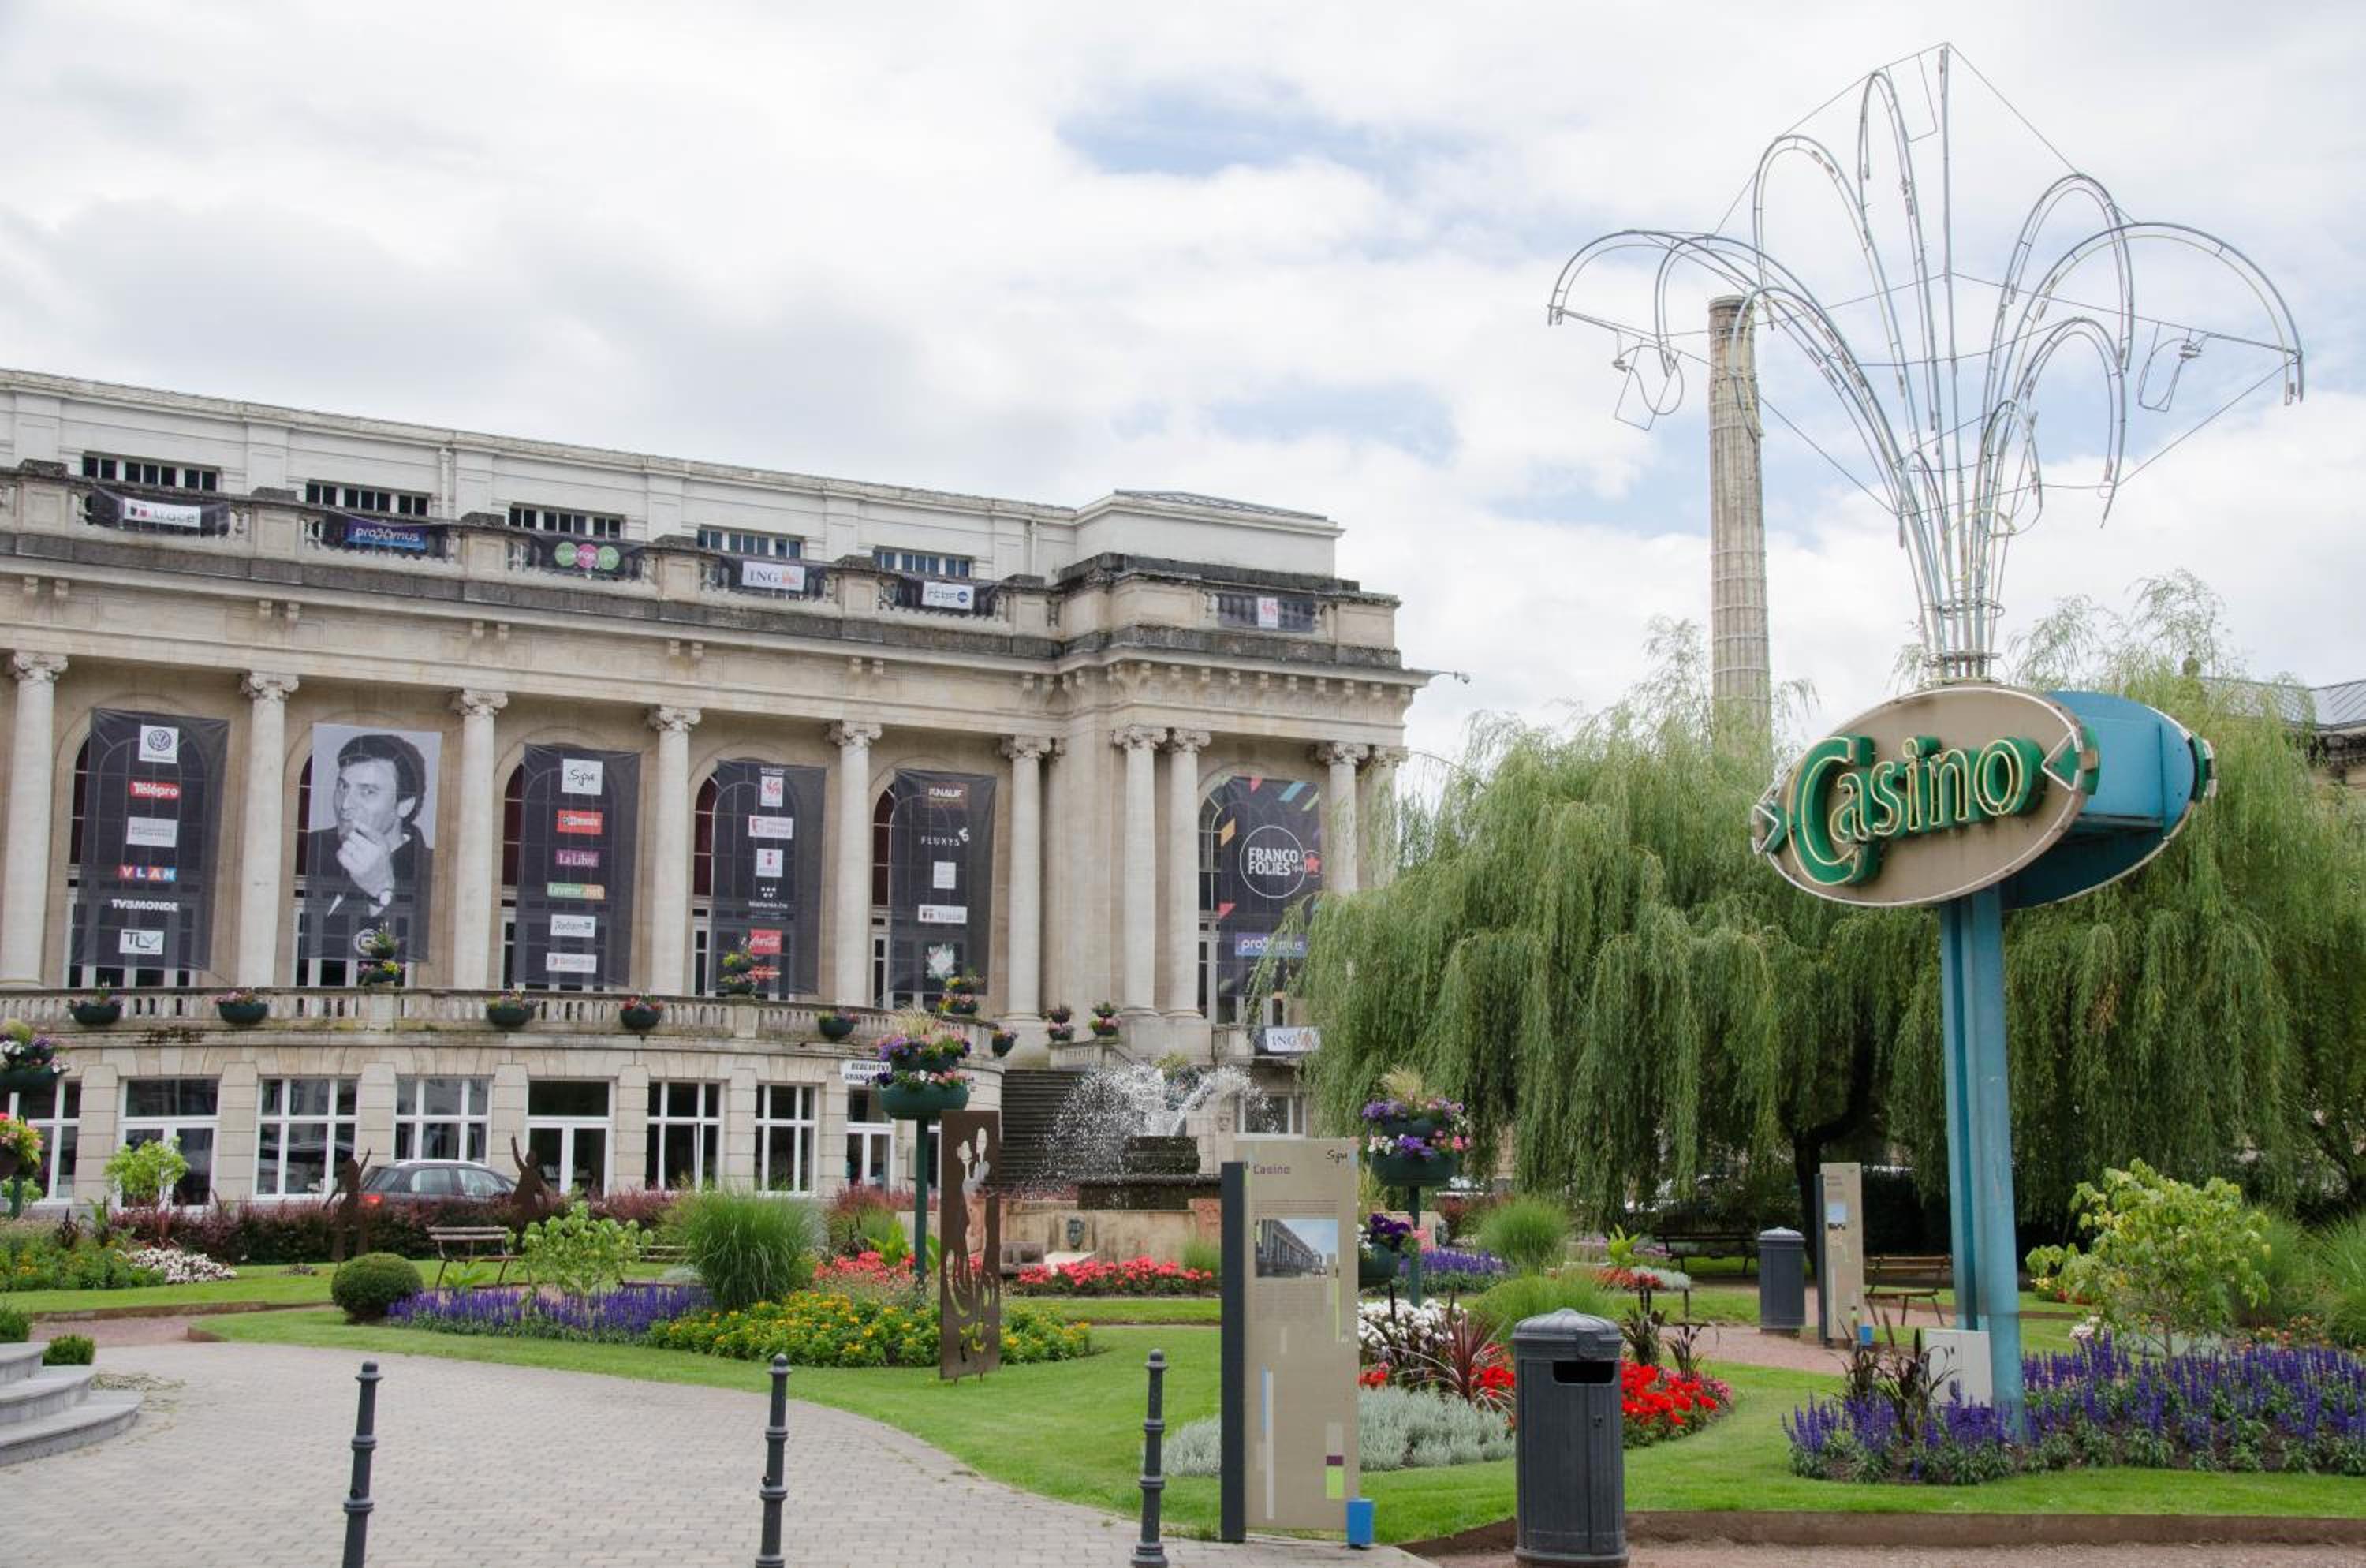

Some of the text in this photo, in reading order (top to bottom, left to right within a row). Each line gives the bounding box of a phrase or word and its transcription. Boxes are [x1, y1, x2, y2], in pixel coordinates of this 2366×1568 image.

[750, 570, 778, 582] ING
[133, 782, 178, 797] Télépro
[1786, 734, 2039, 885] Casino
[1248, 846, 1299, 864] FRANCO
[1248, 860, 1291, 876] FOLIES
[1253, 1164, 1291, 1174] Casino
